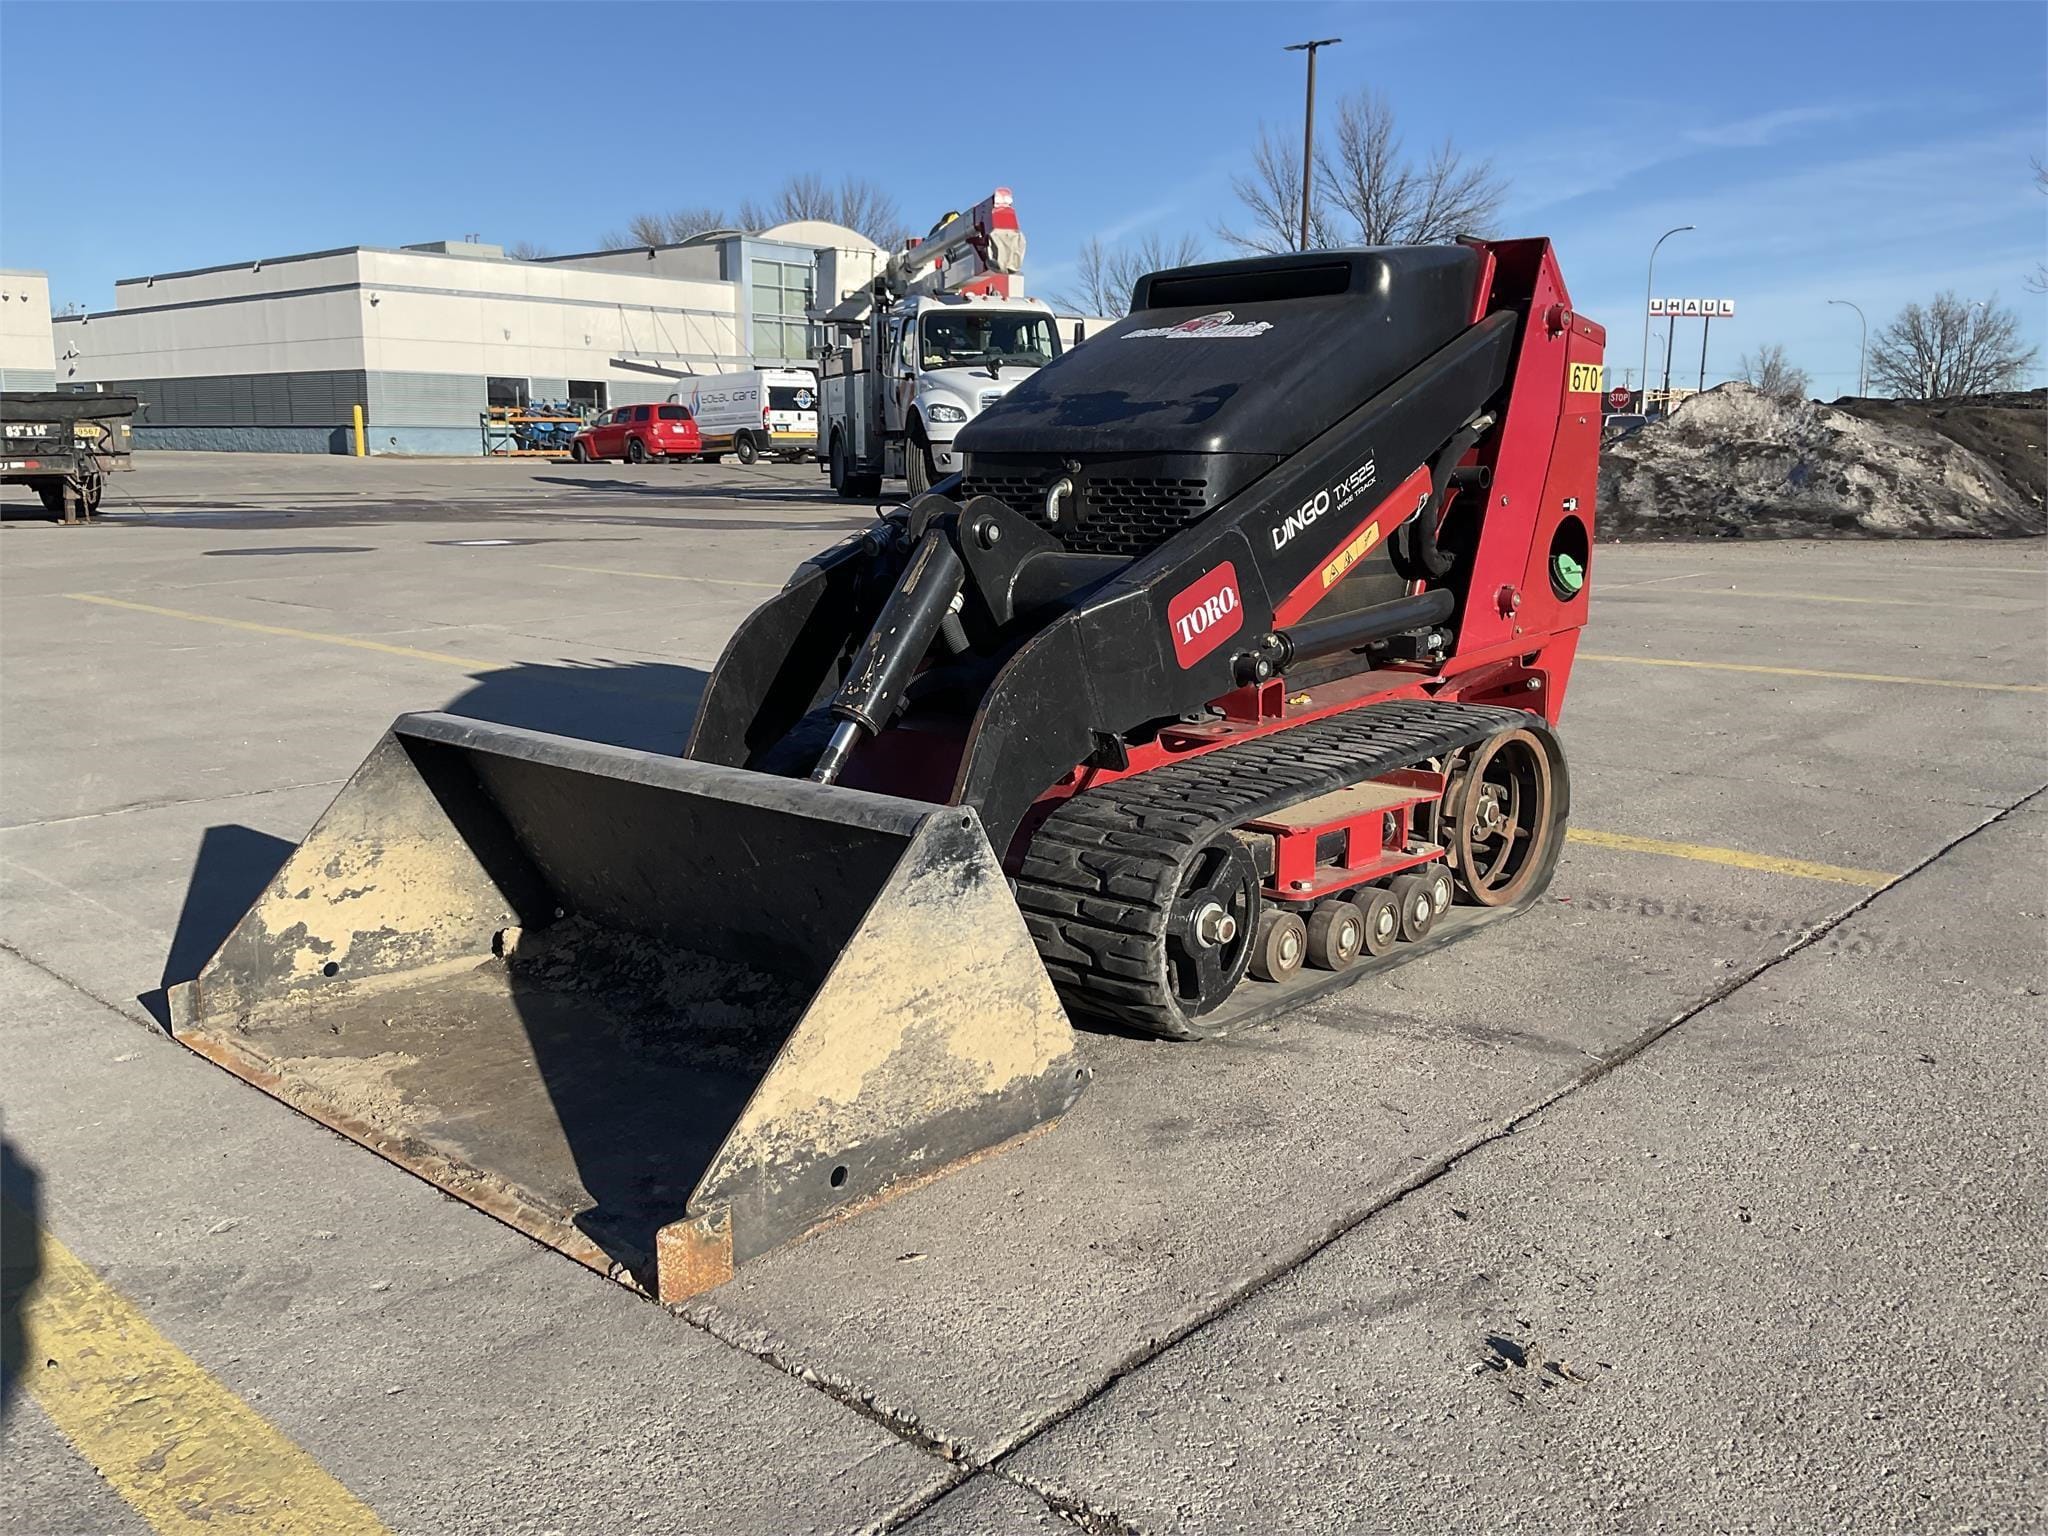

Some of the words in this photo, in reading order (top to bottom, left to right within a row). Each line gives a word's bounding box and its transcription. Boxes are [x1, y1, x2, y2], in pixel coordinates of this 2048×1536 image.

[733, 390, 757, 401] care
[1611, 393, 1628, 402] STOP
[1337, 494, 1354, 511] WIDE
[1355, 476, 1376, 497] TRACK
[1272, 490, 1330, 550] DINGO
[1176, 586, 1236, 645] TORO
